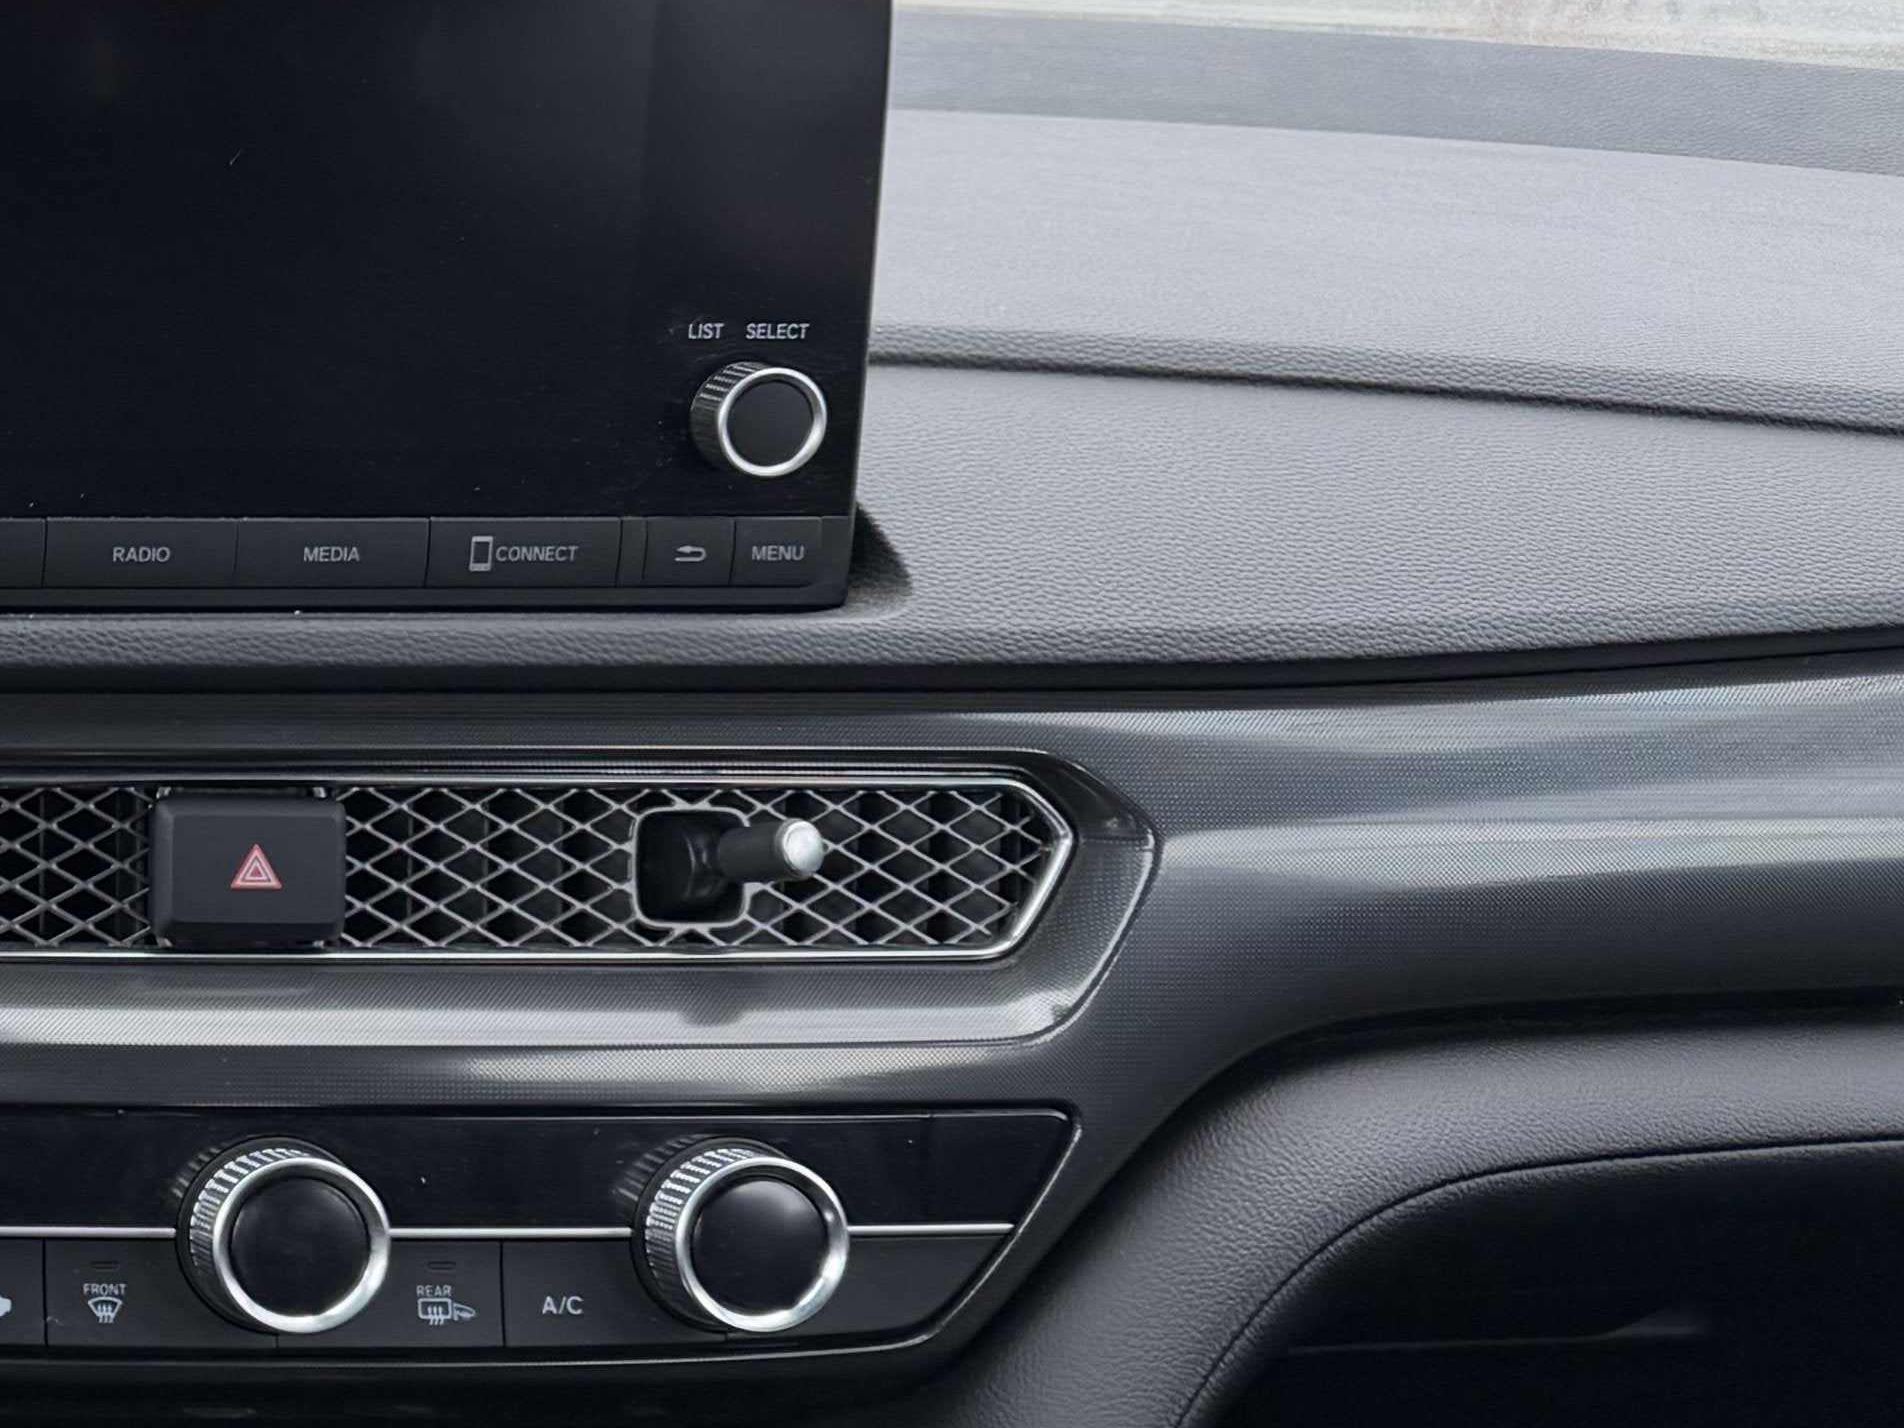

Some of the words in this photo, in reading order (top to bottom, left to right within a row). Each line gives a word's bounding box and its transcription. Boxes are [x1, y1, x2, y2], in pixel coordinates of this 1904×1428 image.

[688, 323, 724, 339] LIST
[746, 323, 809, 339] SELECT
[113, 547, 170, 562] RADIO
[304, 547, 359, 561] MEDIA
[496, 546, 578, 561] CONNECT
[752, 545, 804, 560] MENU
[84, 1283, 126, 1298] FRONT
[417, 1285, 451, 1300] REAR
[542, 1296, 582, 1314] A/C
